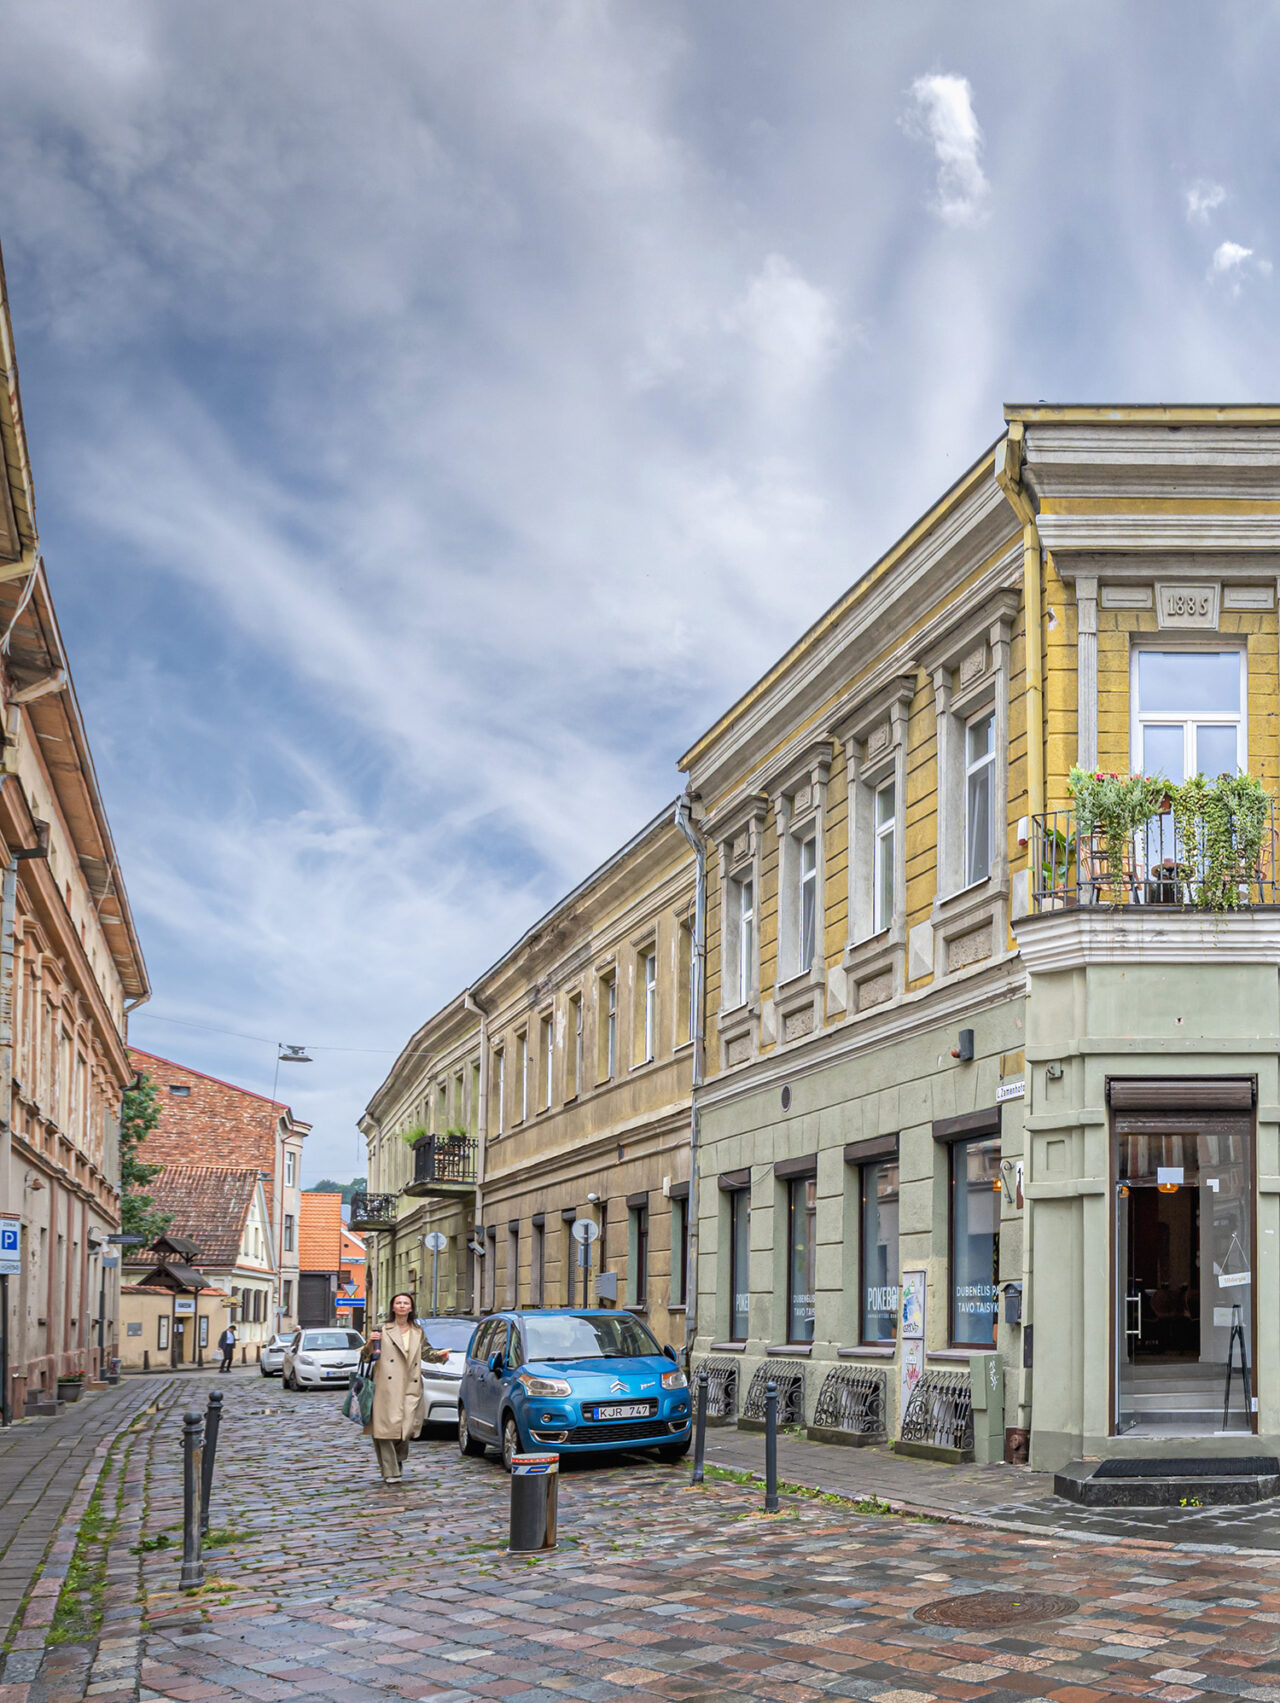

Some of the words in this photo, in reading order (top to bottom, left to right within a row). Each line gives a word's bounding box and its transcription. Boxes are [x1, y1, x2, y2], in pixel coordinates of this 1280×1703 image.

[1167, 595, 1208, 616] 1885
[4, 1232, 14, 1249] P
[958, 1302, 975, 1313] TAVO
[600, 1409, 622, 1418] KJR
[630, 1406, 648, 1416] 747
